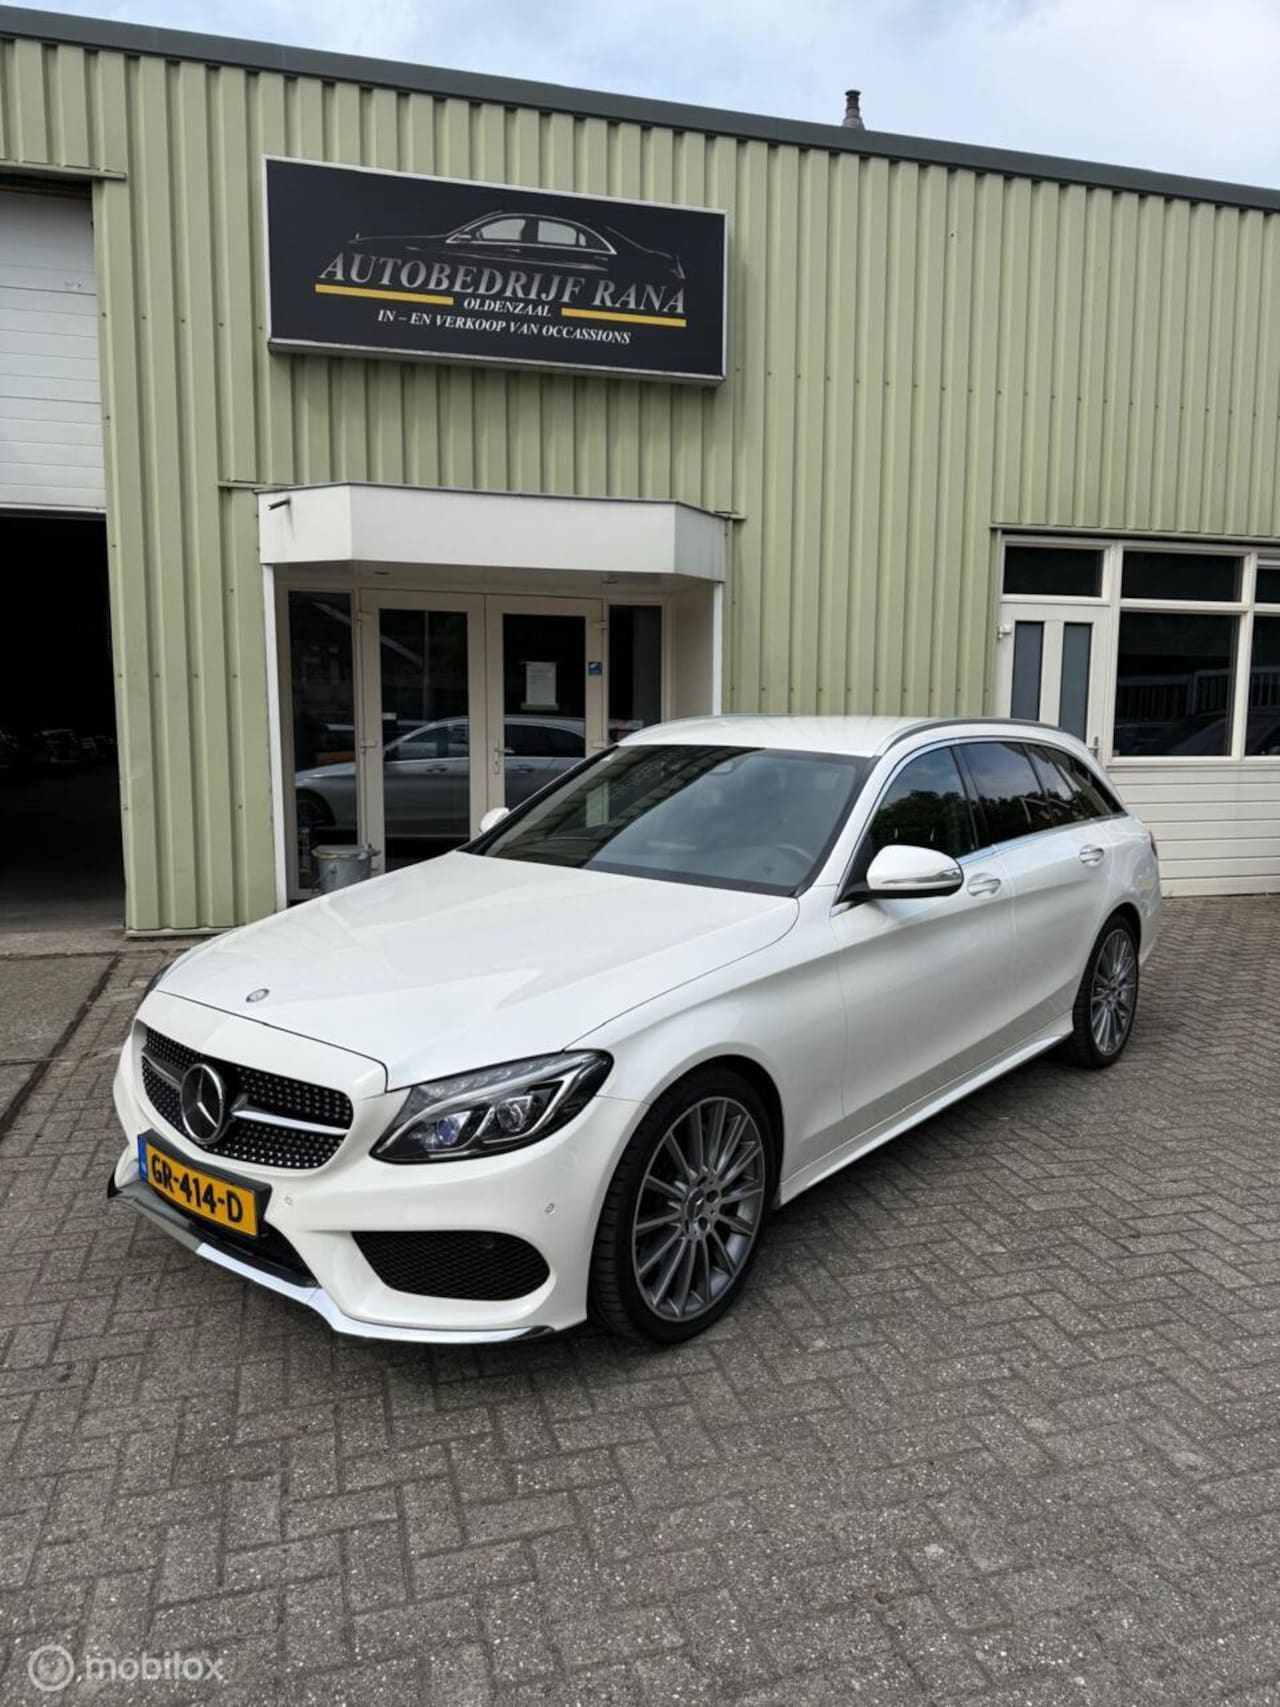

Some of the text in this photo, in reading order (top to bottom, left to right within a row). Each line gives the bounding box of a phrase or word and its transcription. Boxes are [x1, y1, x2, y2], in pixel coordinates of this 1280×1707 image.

[319, 252, 686, 314] AUTOBEDRIJF RANA
[463, 297, 552, 317] OLDENZAAL
[377, 309, 396, 322] IN
[410, 312, 432, 325] EN
[436, 314, 506, 332] VERKOOP
[509, 321, 539, 336] VAN
[542, 325, 631, 344] OCCASSIONS
[151, 1153, 243, 1223] GR-414-D
